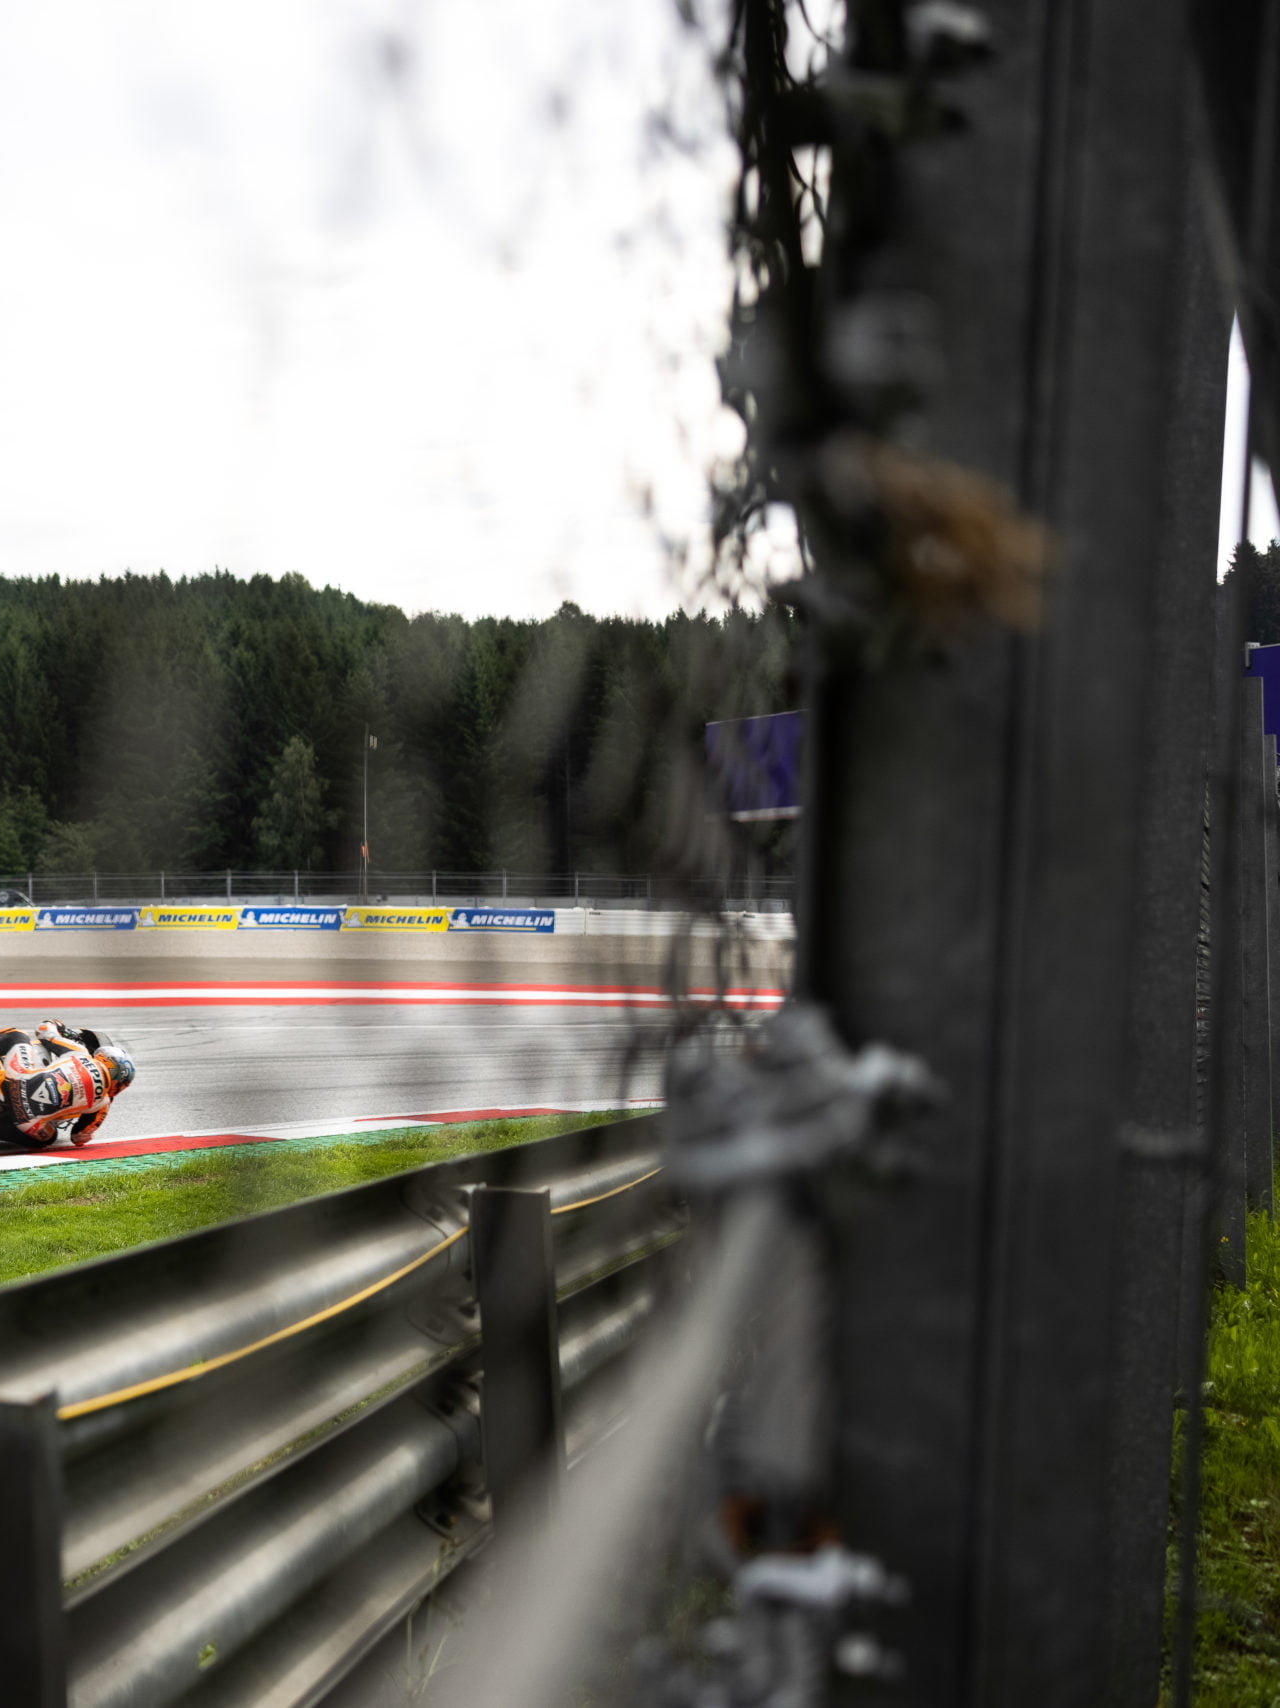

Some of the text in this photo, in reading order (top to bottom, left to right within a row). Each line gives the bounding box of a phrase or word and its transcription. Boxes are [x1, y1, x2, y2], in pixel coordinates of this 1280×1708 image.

[55, 914, 132, 924] MICHELIN
[158, 914, 232, 923] MICHELIN
[258, 913, 337, 924] MICHELIN
[365, 914, 443, 925] MICHELIN
[471, 914, 553, 927] MICHELIN
